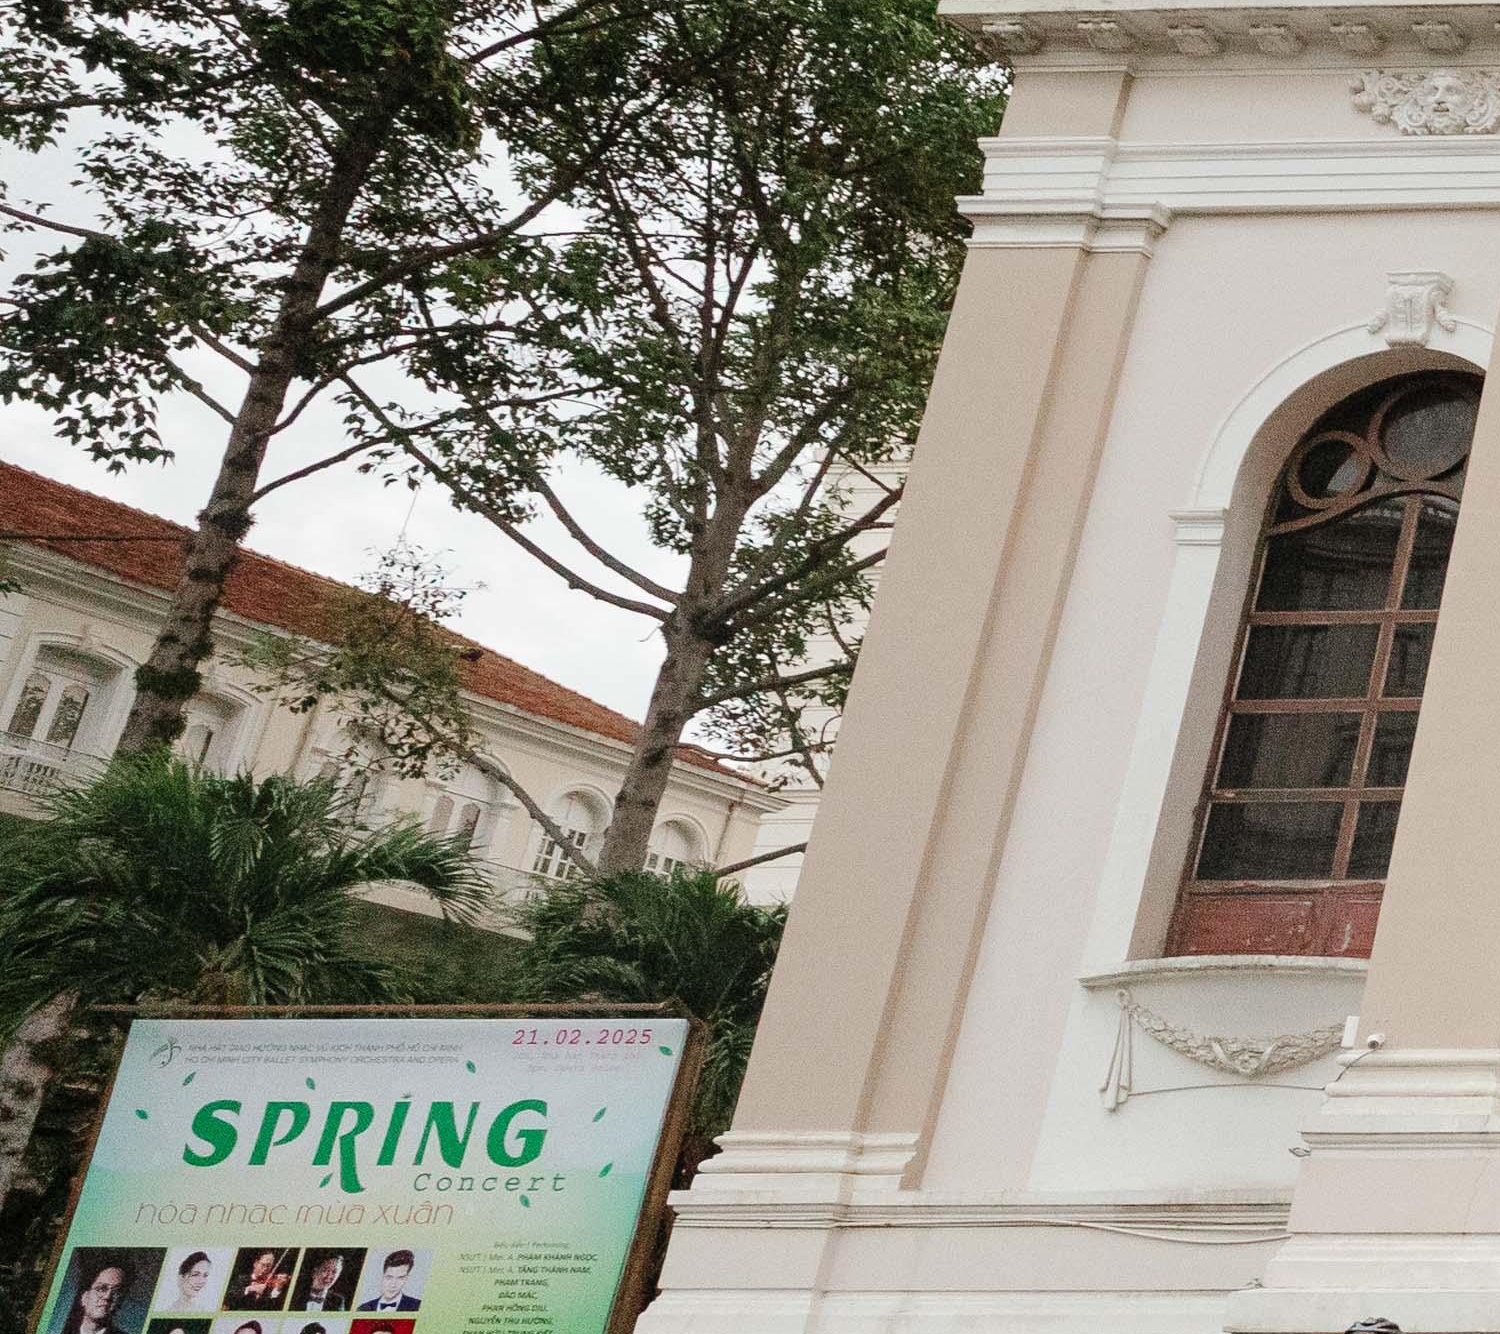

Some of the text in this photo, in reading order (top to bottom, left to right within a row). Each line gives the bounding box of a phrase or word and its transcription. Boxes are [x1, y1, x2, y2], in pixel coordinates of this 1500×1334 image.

[512, 1028, 653, 1045] 21.02.2025
[183, 1099, 548, 1194] SPRING
[414, 1172, 566, 1192] Concert
